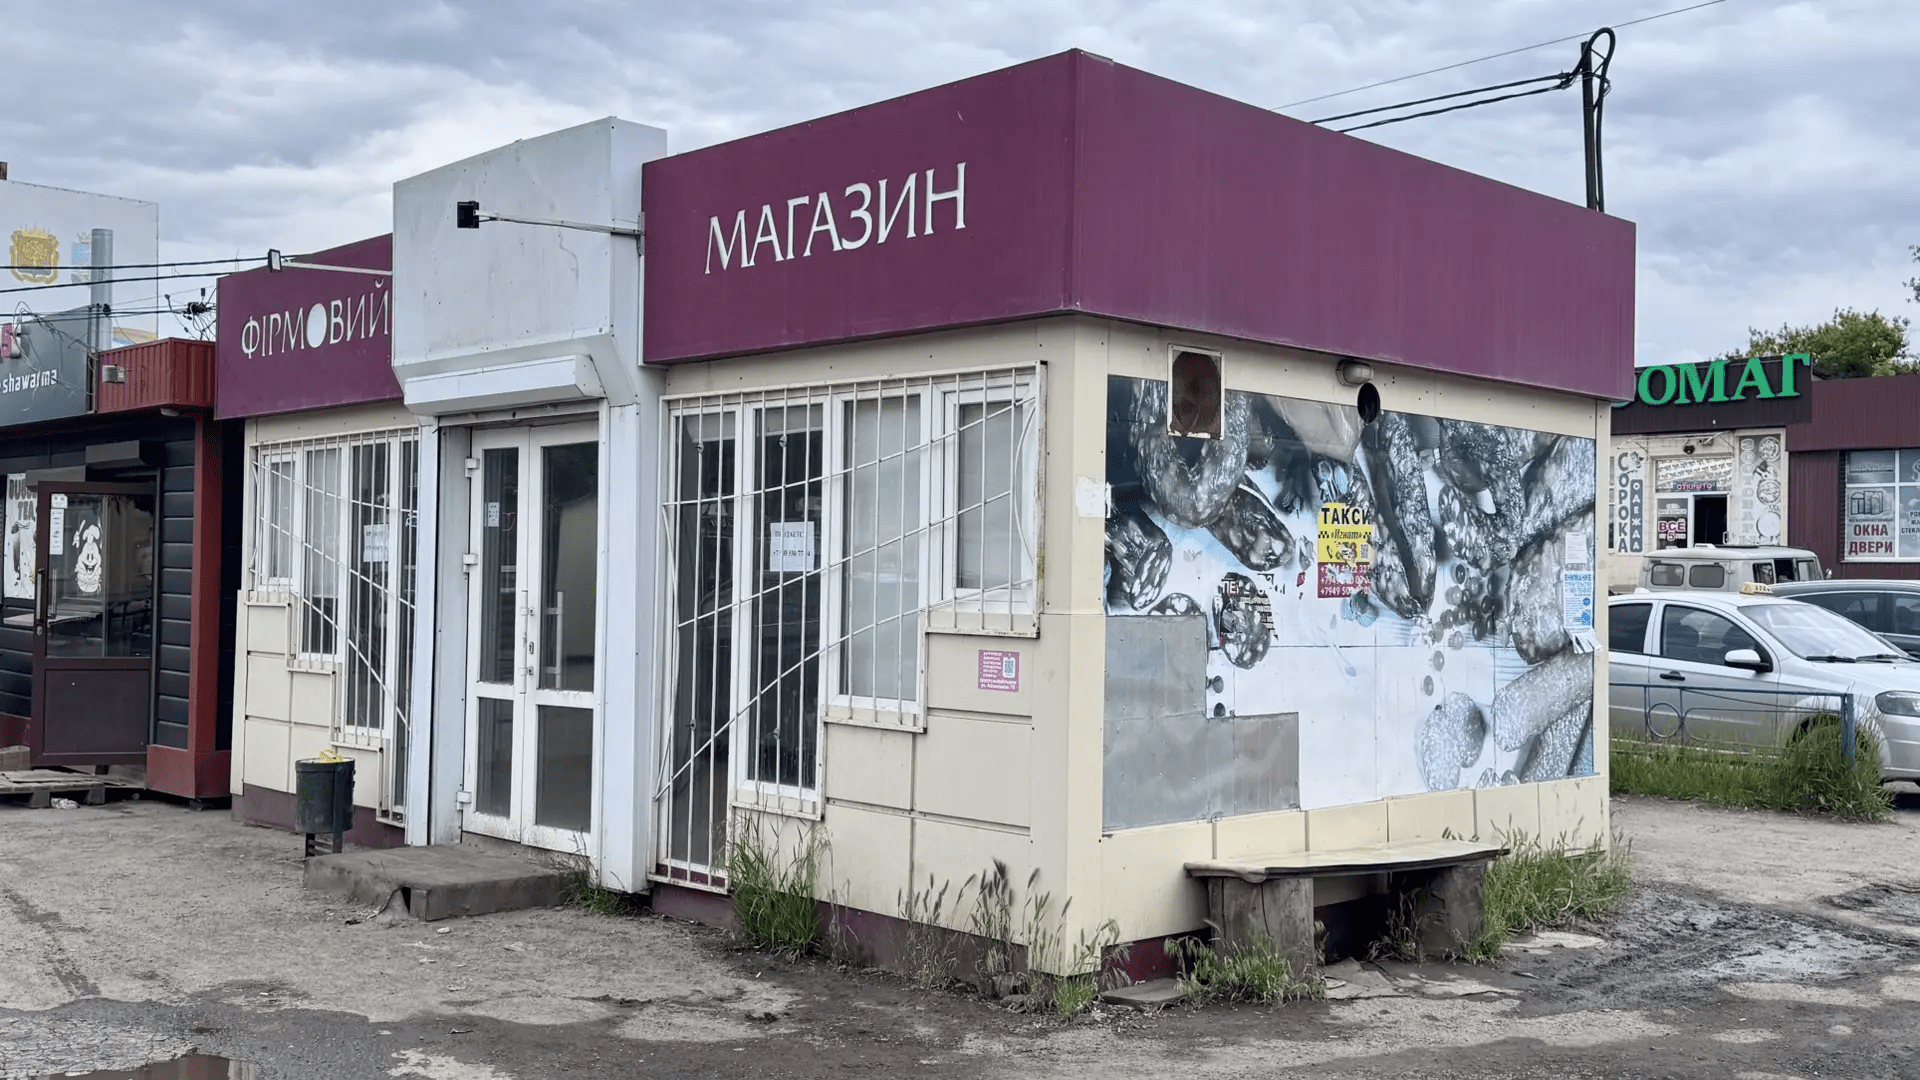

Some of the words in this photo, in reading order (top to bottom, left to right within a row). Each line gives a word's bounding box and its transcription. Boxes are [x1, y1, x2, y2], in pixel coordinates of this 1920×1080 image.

[705, 162, 966, 274] МАГАЗИН
[1611, 353, 1811, 407] ОМАГ
[18, 501, 34, 520] TEA
[1618, 452, 1629, 553] СОРОКА
[1321, 507, 1371, 525] ТАКСИ
[1853, 524, 1888, 536] ОКНА
[1848, 541, 1893, 555] ДВЕРИ
